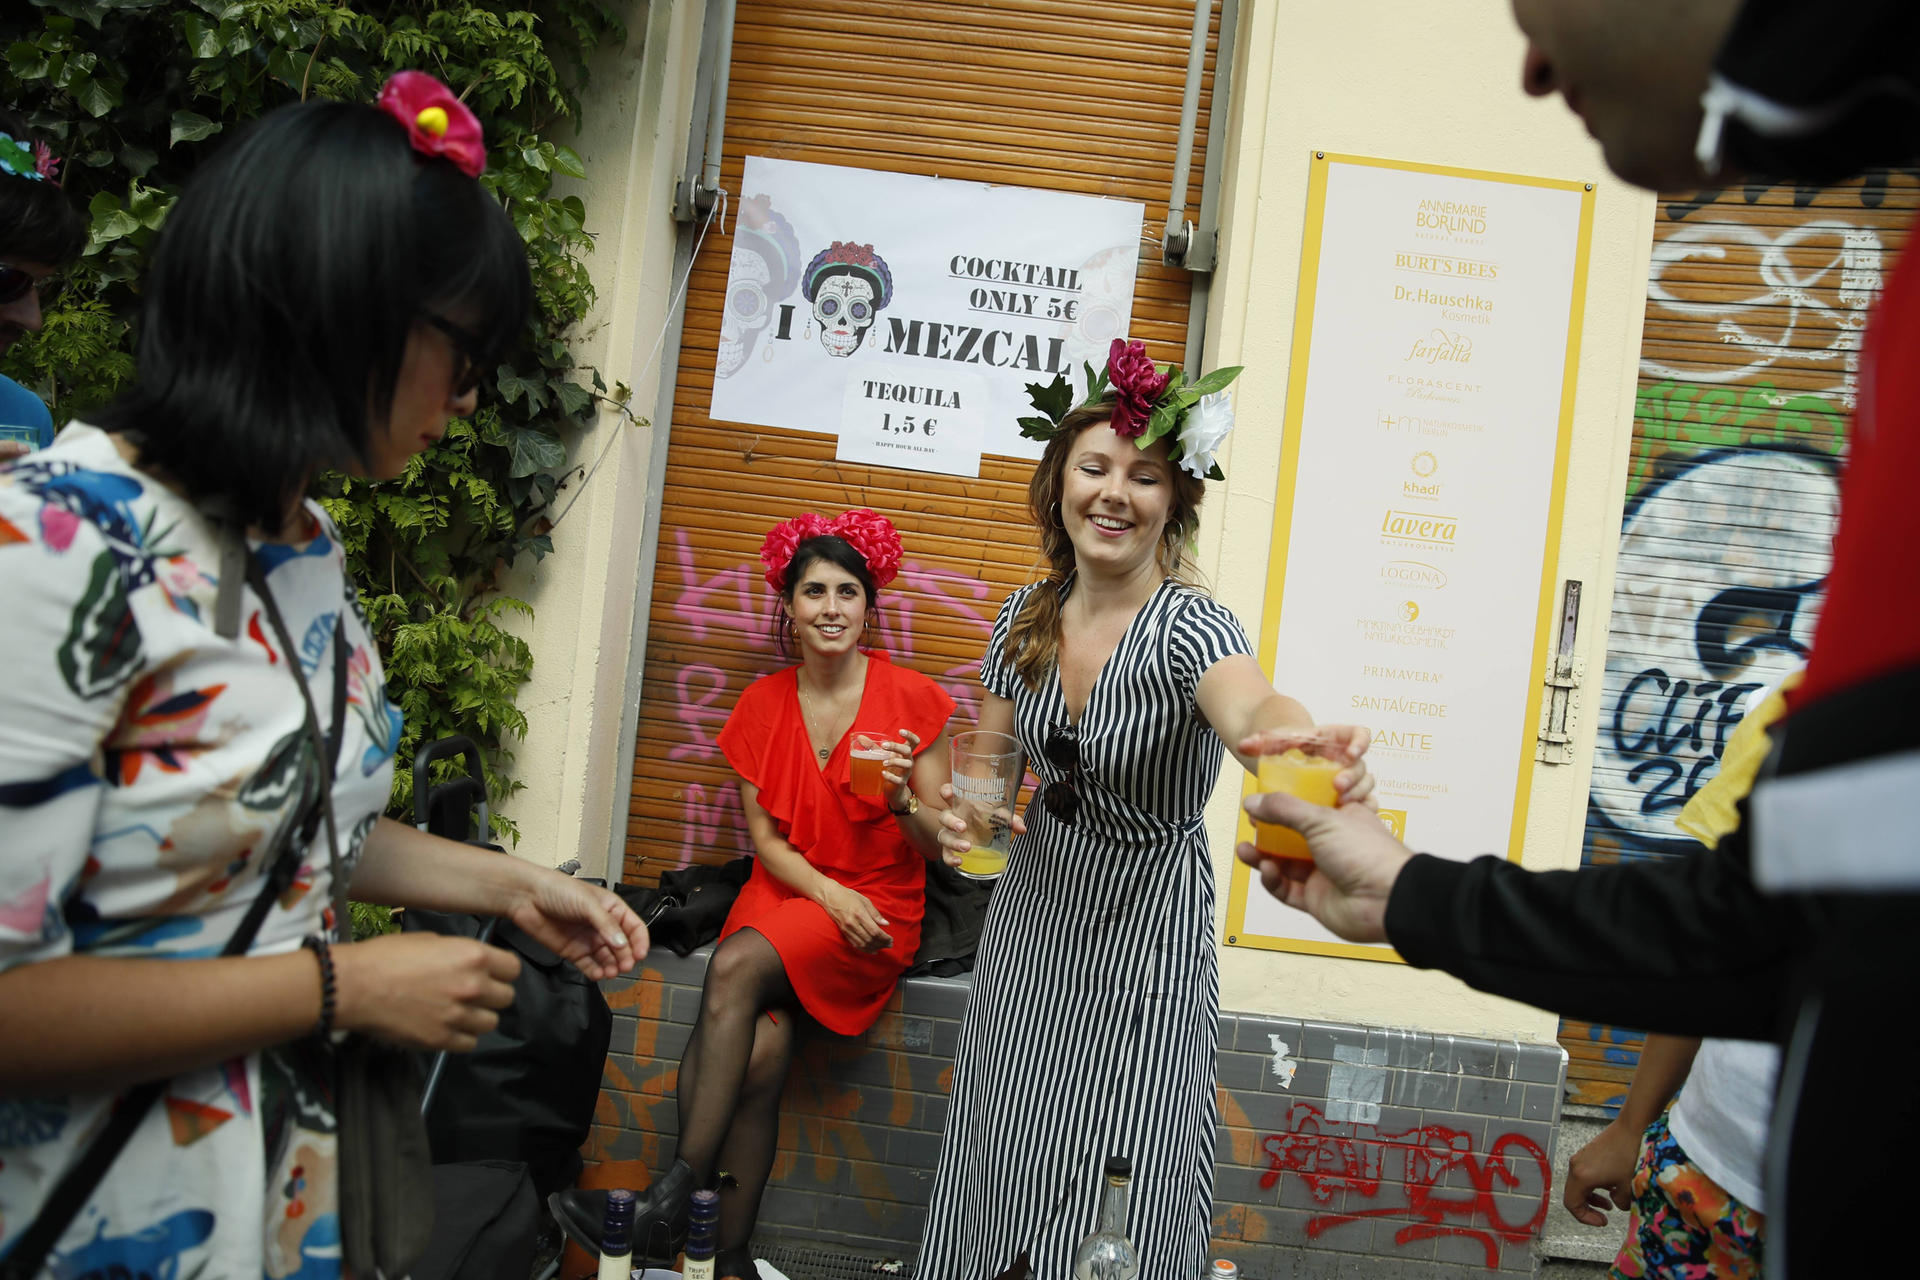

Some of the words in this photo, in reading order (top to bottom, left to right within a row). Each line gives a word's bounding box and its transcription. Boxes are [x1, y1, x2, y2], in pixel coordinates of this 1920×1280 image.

[1418, 199, 1487, 219] ANNEMARIE
[949, 254, 1083, 292] COCKTAIL
[1395, 253, 1453, 274] BURT'S
[1457, 260, 1499, 279] BEES
[970, 288, 1039, 316] ONLY
[1046, 297, 1079, 321] 5€
[1440, 308, 1492, 325] Kosmetik
[775, 303, 796, 341] I
[883, 317, 1072, 376] MEZCAL
[863, 379, 962, 410] TEQUILA
[1387, 374, 1483, 393] FLORASCENT
[923, 417, 938, 437] €
[875, 441, 894, 449] HAPPY
[895, 443, 912, 451] HOUR
[1403, 480, 1440, 496] khadi
[1381, 509, 1457, 540] lavera
[1380, 564, 1441, 585] LOGONA
[1351, 694, 1448, 718] SANTAVERDE
